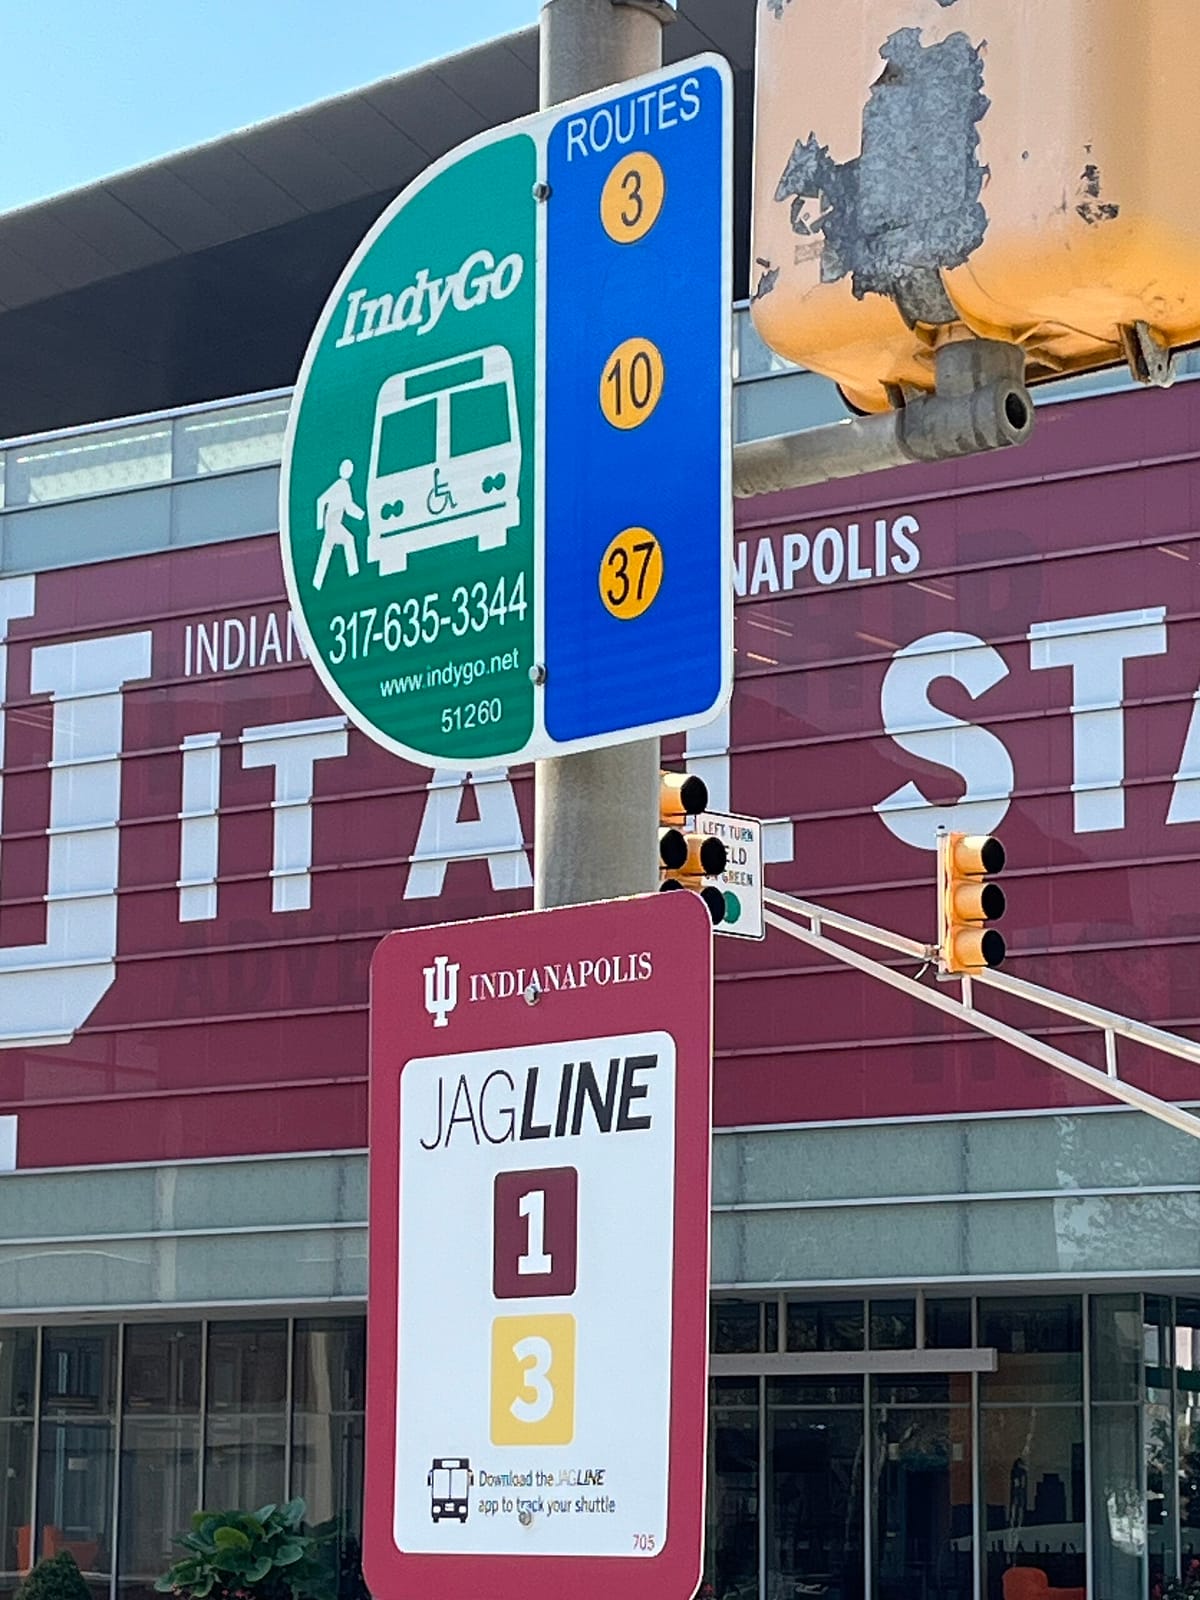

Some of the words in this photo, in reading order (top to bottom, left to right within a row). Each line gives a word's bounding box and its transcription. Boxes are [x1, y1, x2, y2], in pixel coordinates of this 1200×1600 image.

[567, 77, 700, 161] ROUTES
[621, 169, 643, 227] 3
[336, 249, 524, 348] IndyGo
[607, 351, 651, 415] 10
[184, 609, 309, 677] INDIAN
[730, 514, 920, 598] NAPOLIS
[607, 541, 656, 606] 37
[329, 571, 528, 665] 317-635-3344
[380, 647, 520, 698] www.indygo.net
[441, 698, 502, 733] 51260
[703, 821, 726, 837] LEFT
[729, 825, 754, 842] TURN
[469, 952, 652, 1002] INDIANAPOLIS
[420, 1054, 658, 1149] JAGLINE
[518, 1190, 552, 1274] 1
[510, 1335, 554, 1423] 3
[478, 1499, 499, 1516] app
[501, 1495, 513, 1512] to
[516, 1495, 544, 1513] track
[546, 1499, 572, 1517] your
[574, 1495, 616, 1513] shuttle
[479, 1469, 533, 1487] Download
[535, 1469, 554, 1487] the
[632, 1534, 656, 1551] 705
